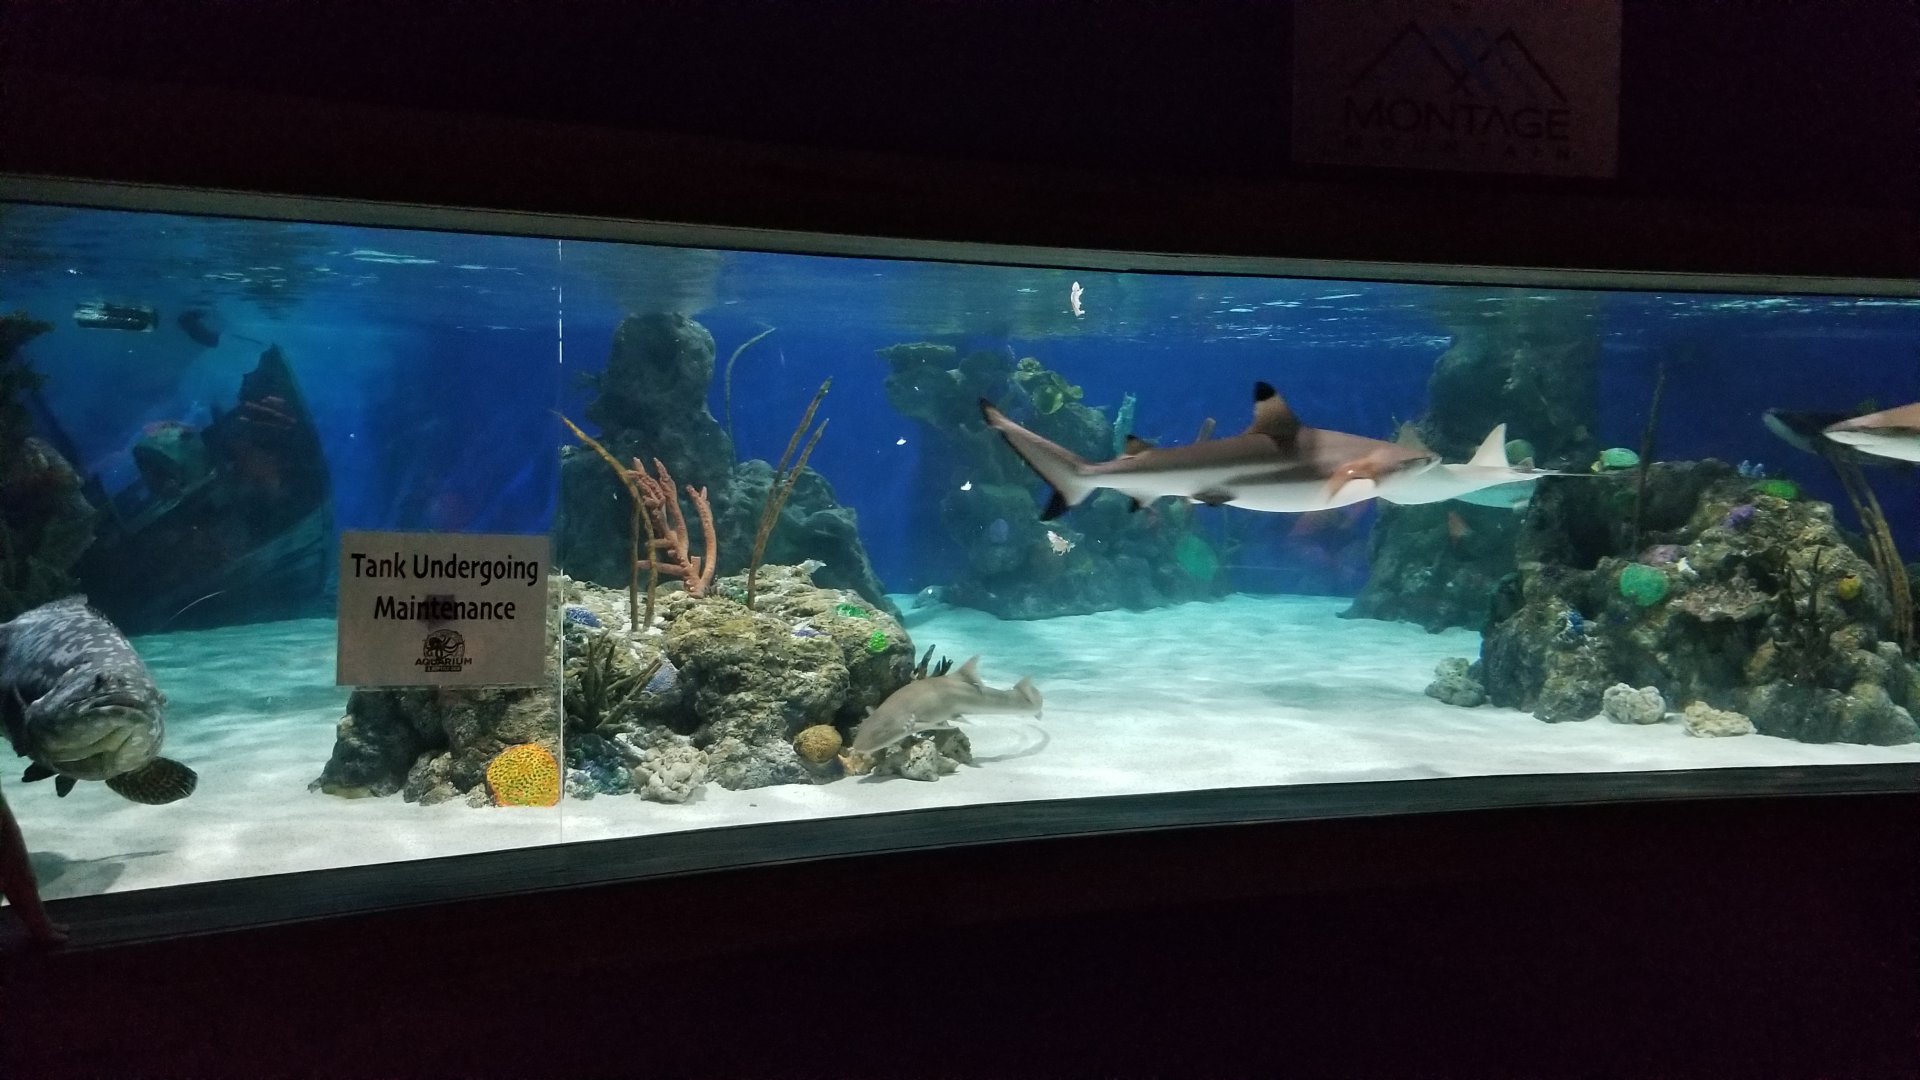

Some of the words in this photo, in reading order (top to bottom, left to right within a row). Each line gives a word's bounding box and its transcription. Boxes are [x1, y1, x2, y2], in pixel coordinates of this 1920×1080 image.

[1344, 96, 1571, 141] MONTAGE
[351, 552, 406, 579] Tank
[413, 553, 539, 587] Undergoing
[374, 595, 516, 620] Maintenance
[415, 657, 473, 666] AQUARIUM
